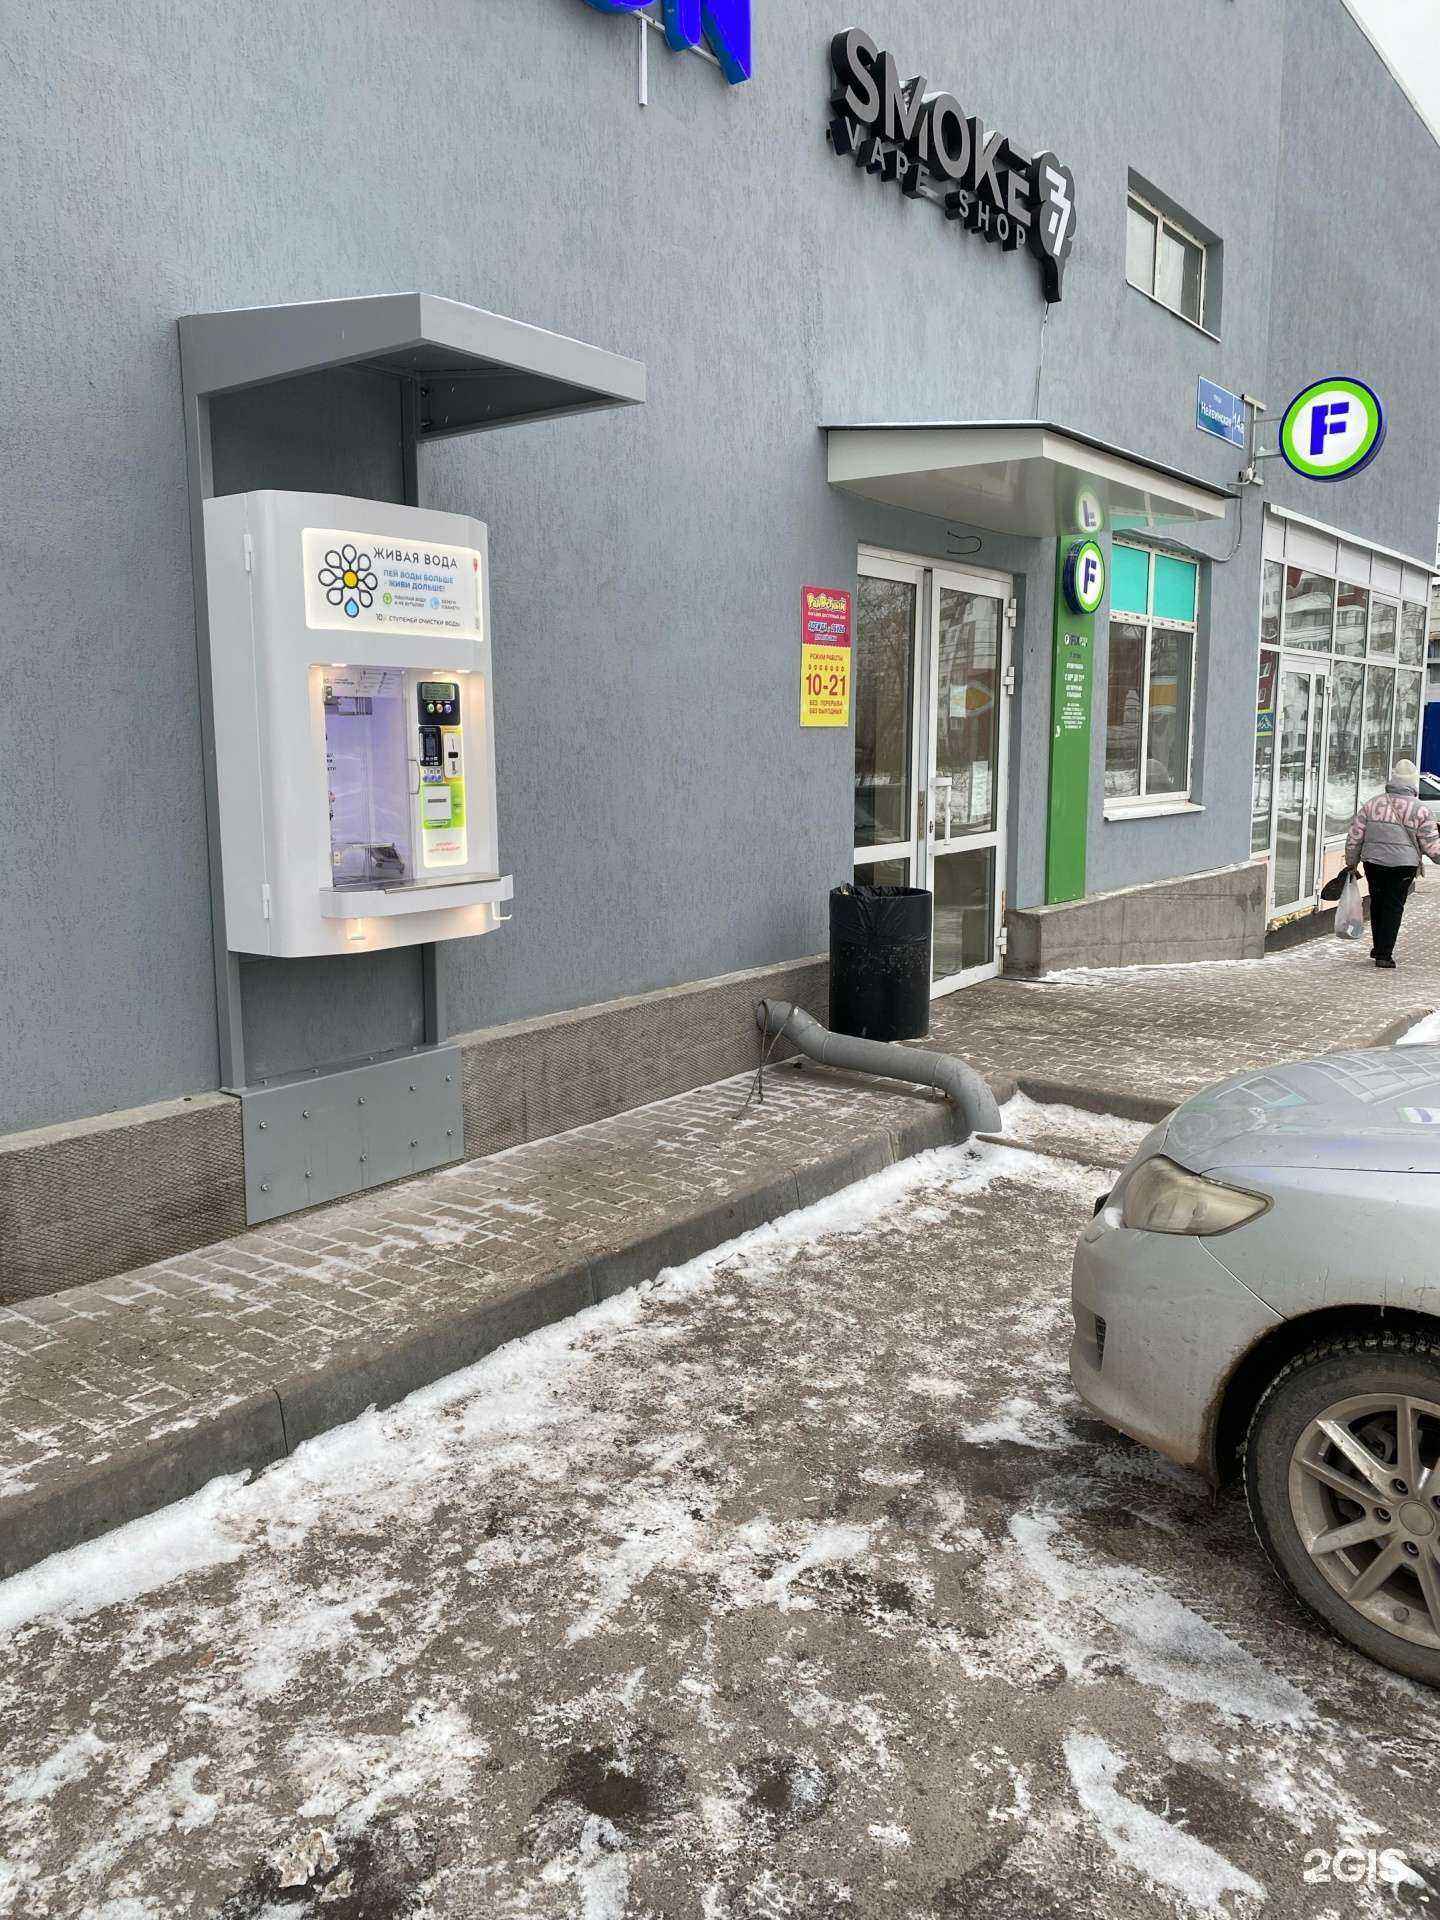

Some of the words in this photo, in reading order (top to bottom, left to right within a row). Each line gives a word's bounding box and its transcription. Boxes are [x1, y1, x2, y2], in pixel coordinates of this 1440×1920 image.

[833, 26, 1032, 227] SMOKE
[840, 116, 939, 199] VAPE
[956, 189, 1027, 249] SHOP
[1310, 402, 1350, 456] F
[373, 547, 419, 564] ЖИВАЯ
[424, 554, 458, 570] ВОДА
[383, 569, 399, 578] ПЕЙ
[423, 574, 455, 585] БОЛЬШЕ
[1084, 557, 1097, 595] F
[806, 673, 846, 696] 10-21
